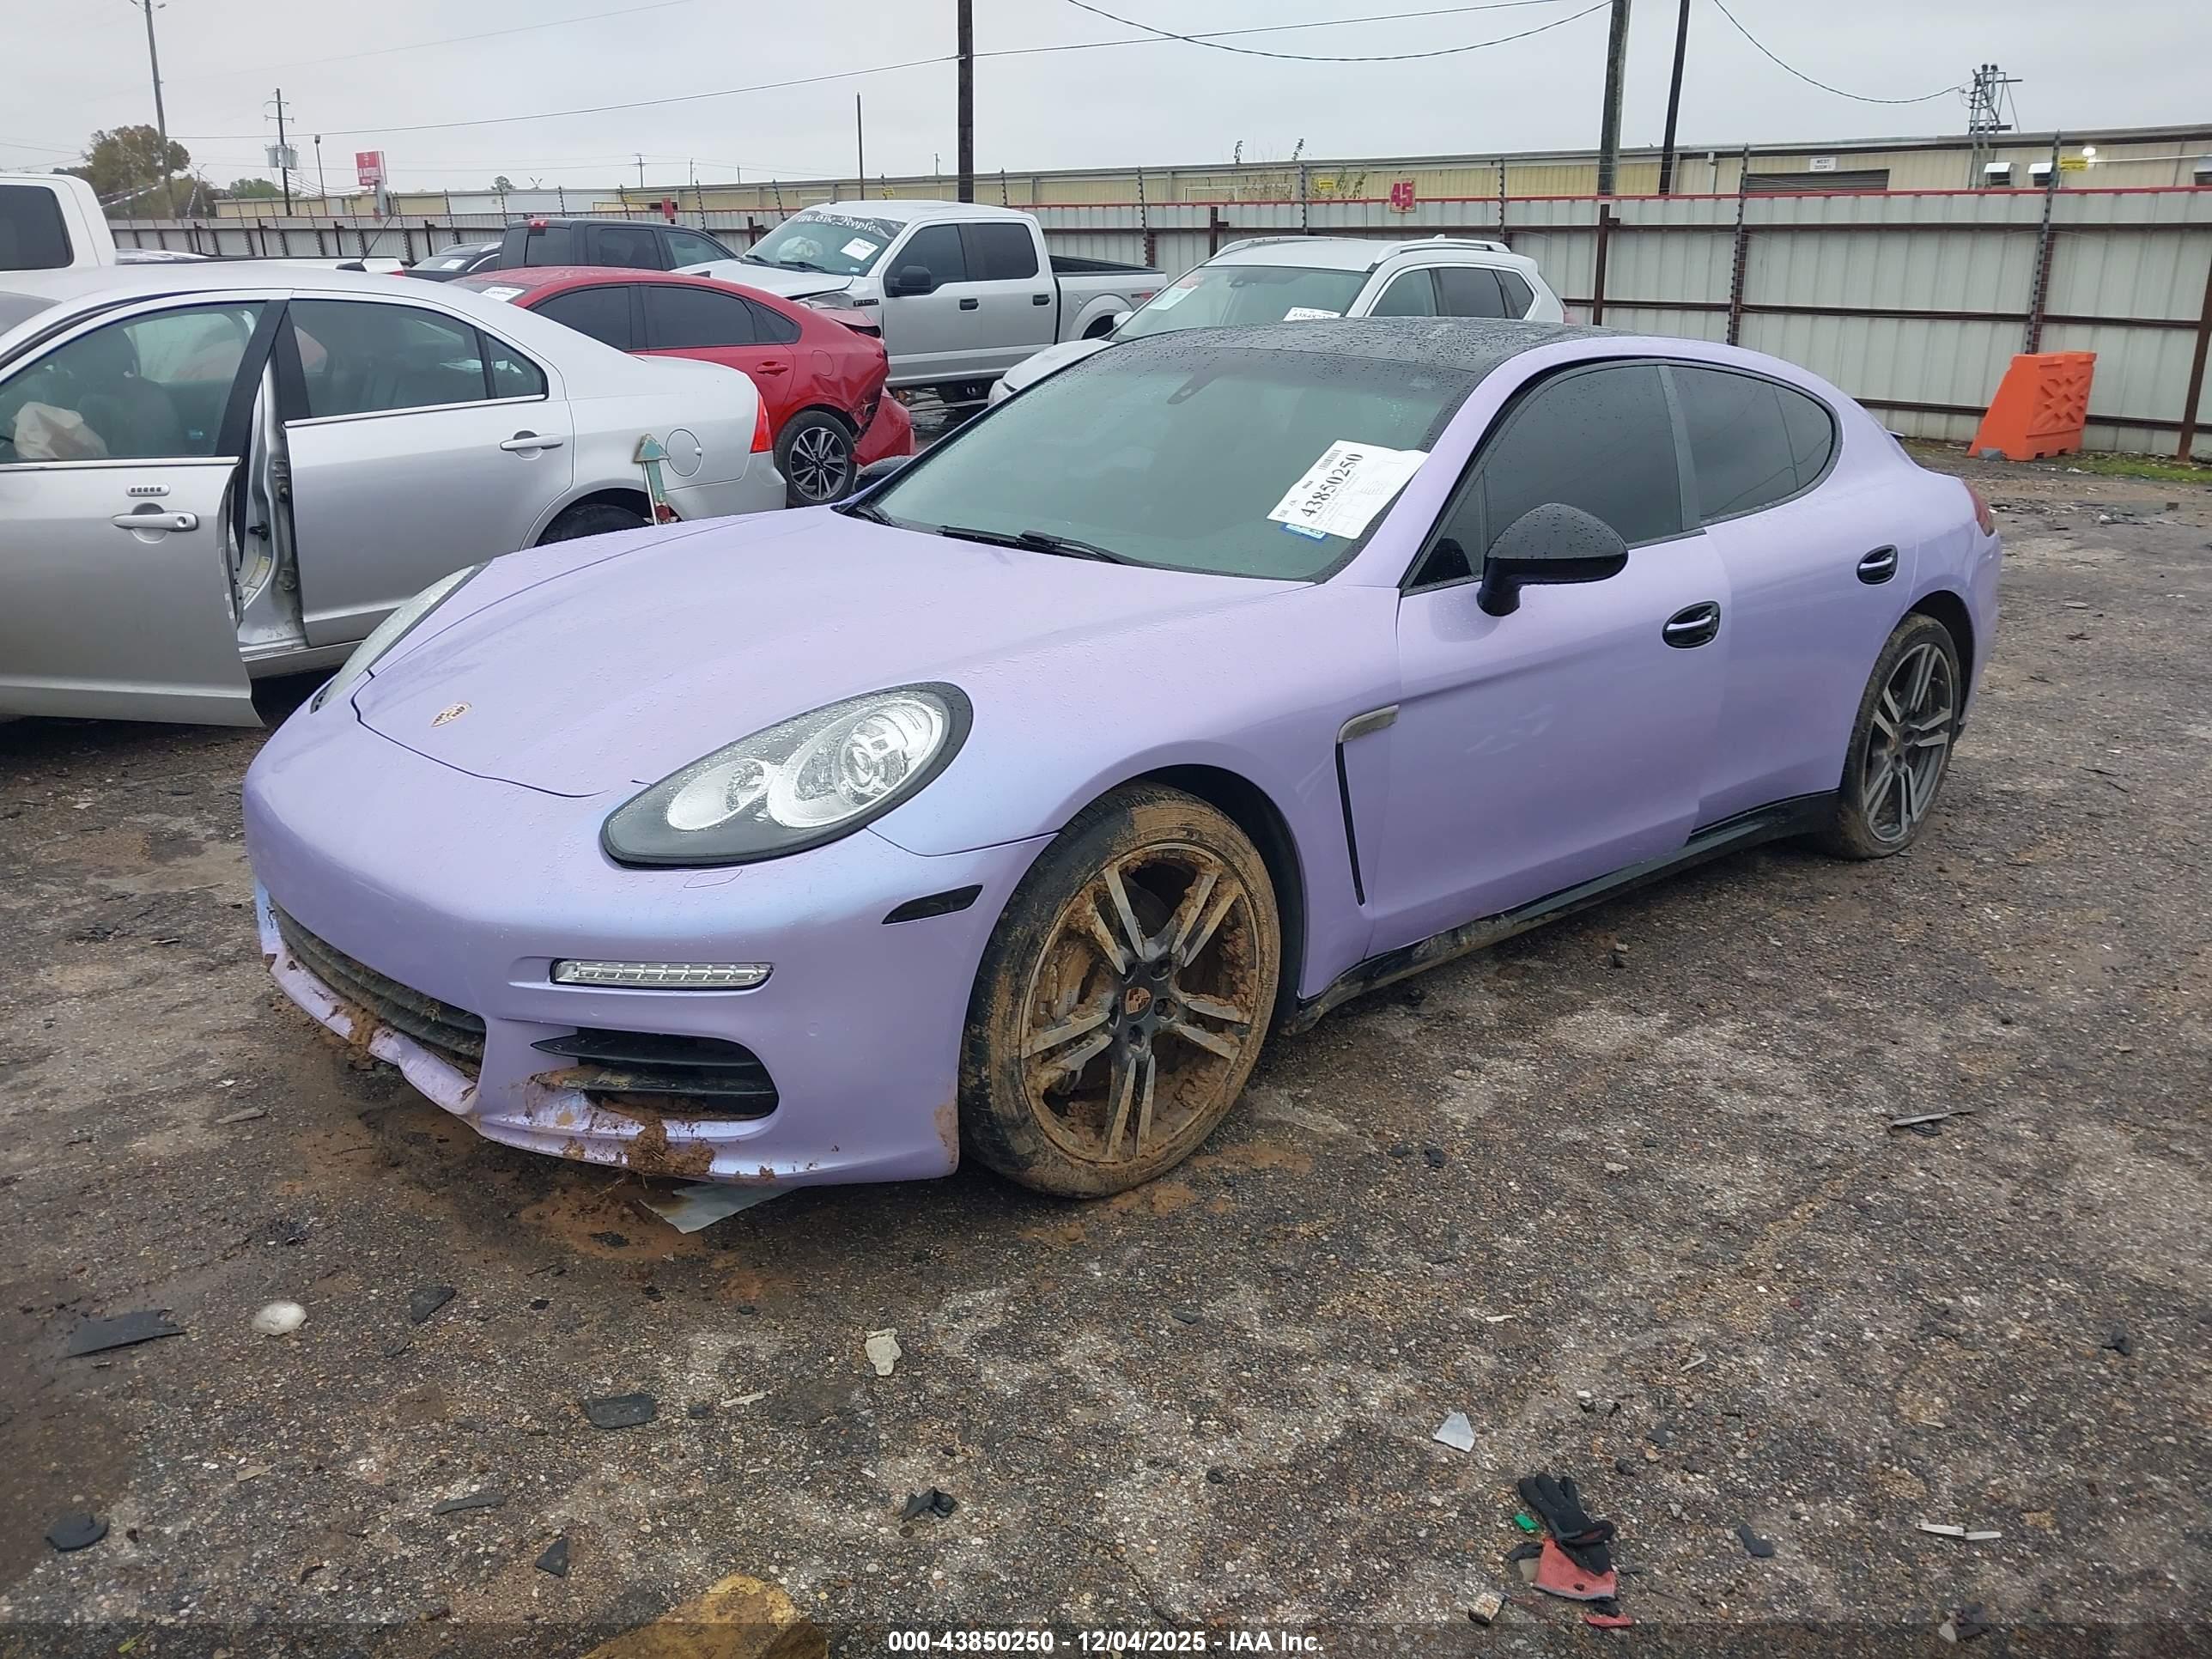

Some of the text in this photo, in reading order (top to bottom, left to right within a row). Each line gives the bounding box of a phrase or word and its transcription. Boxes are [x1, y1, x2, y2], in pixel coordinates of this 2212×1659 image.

[1391, 183, 1413, 207] 45
[832, 216, 876, 231] People
[1300, 453, 1364, 517] 43850250
